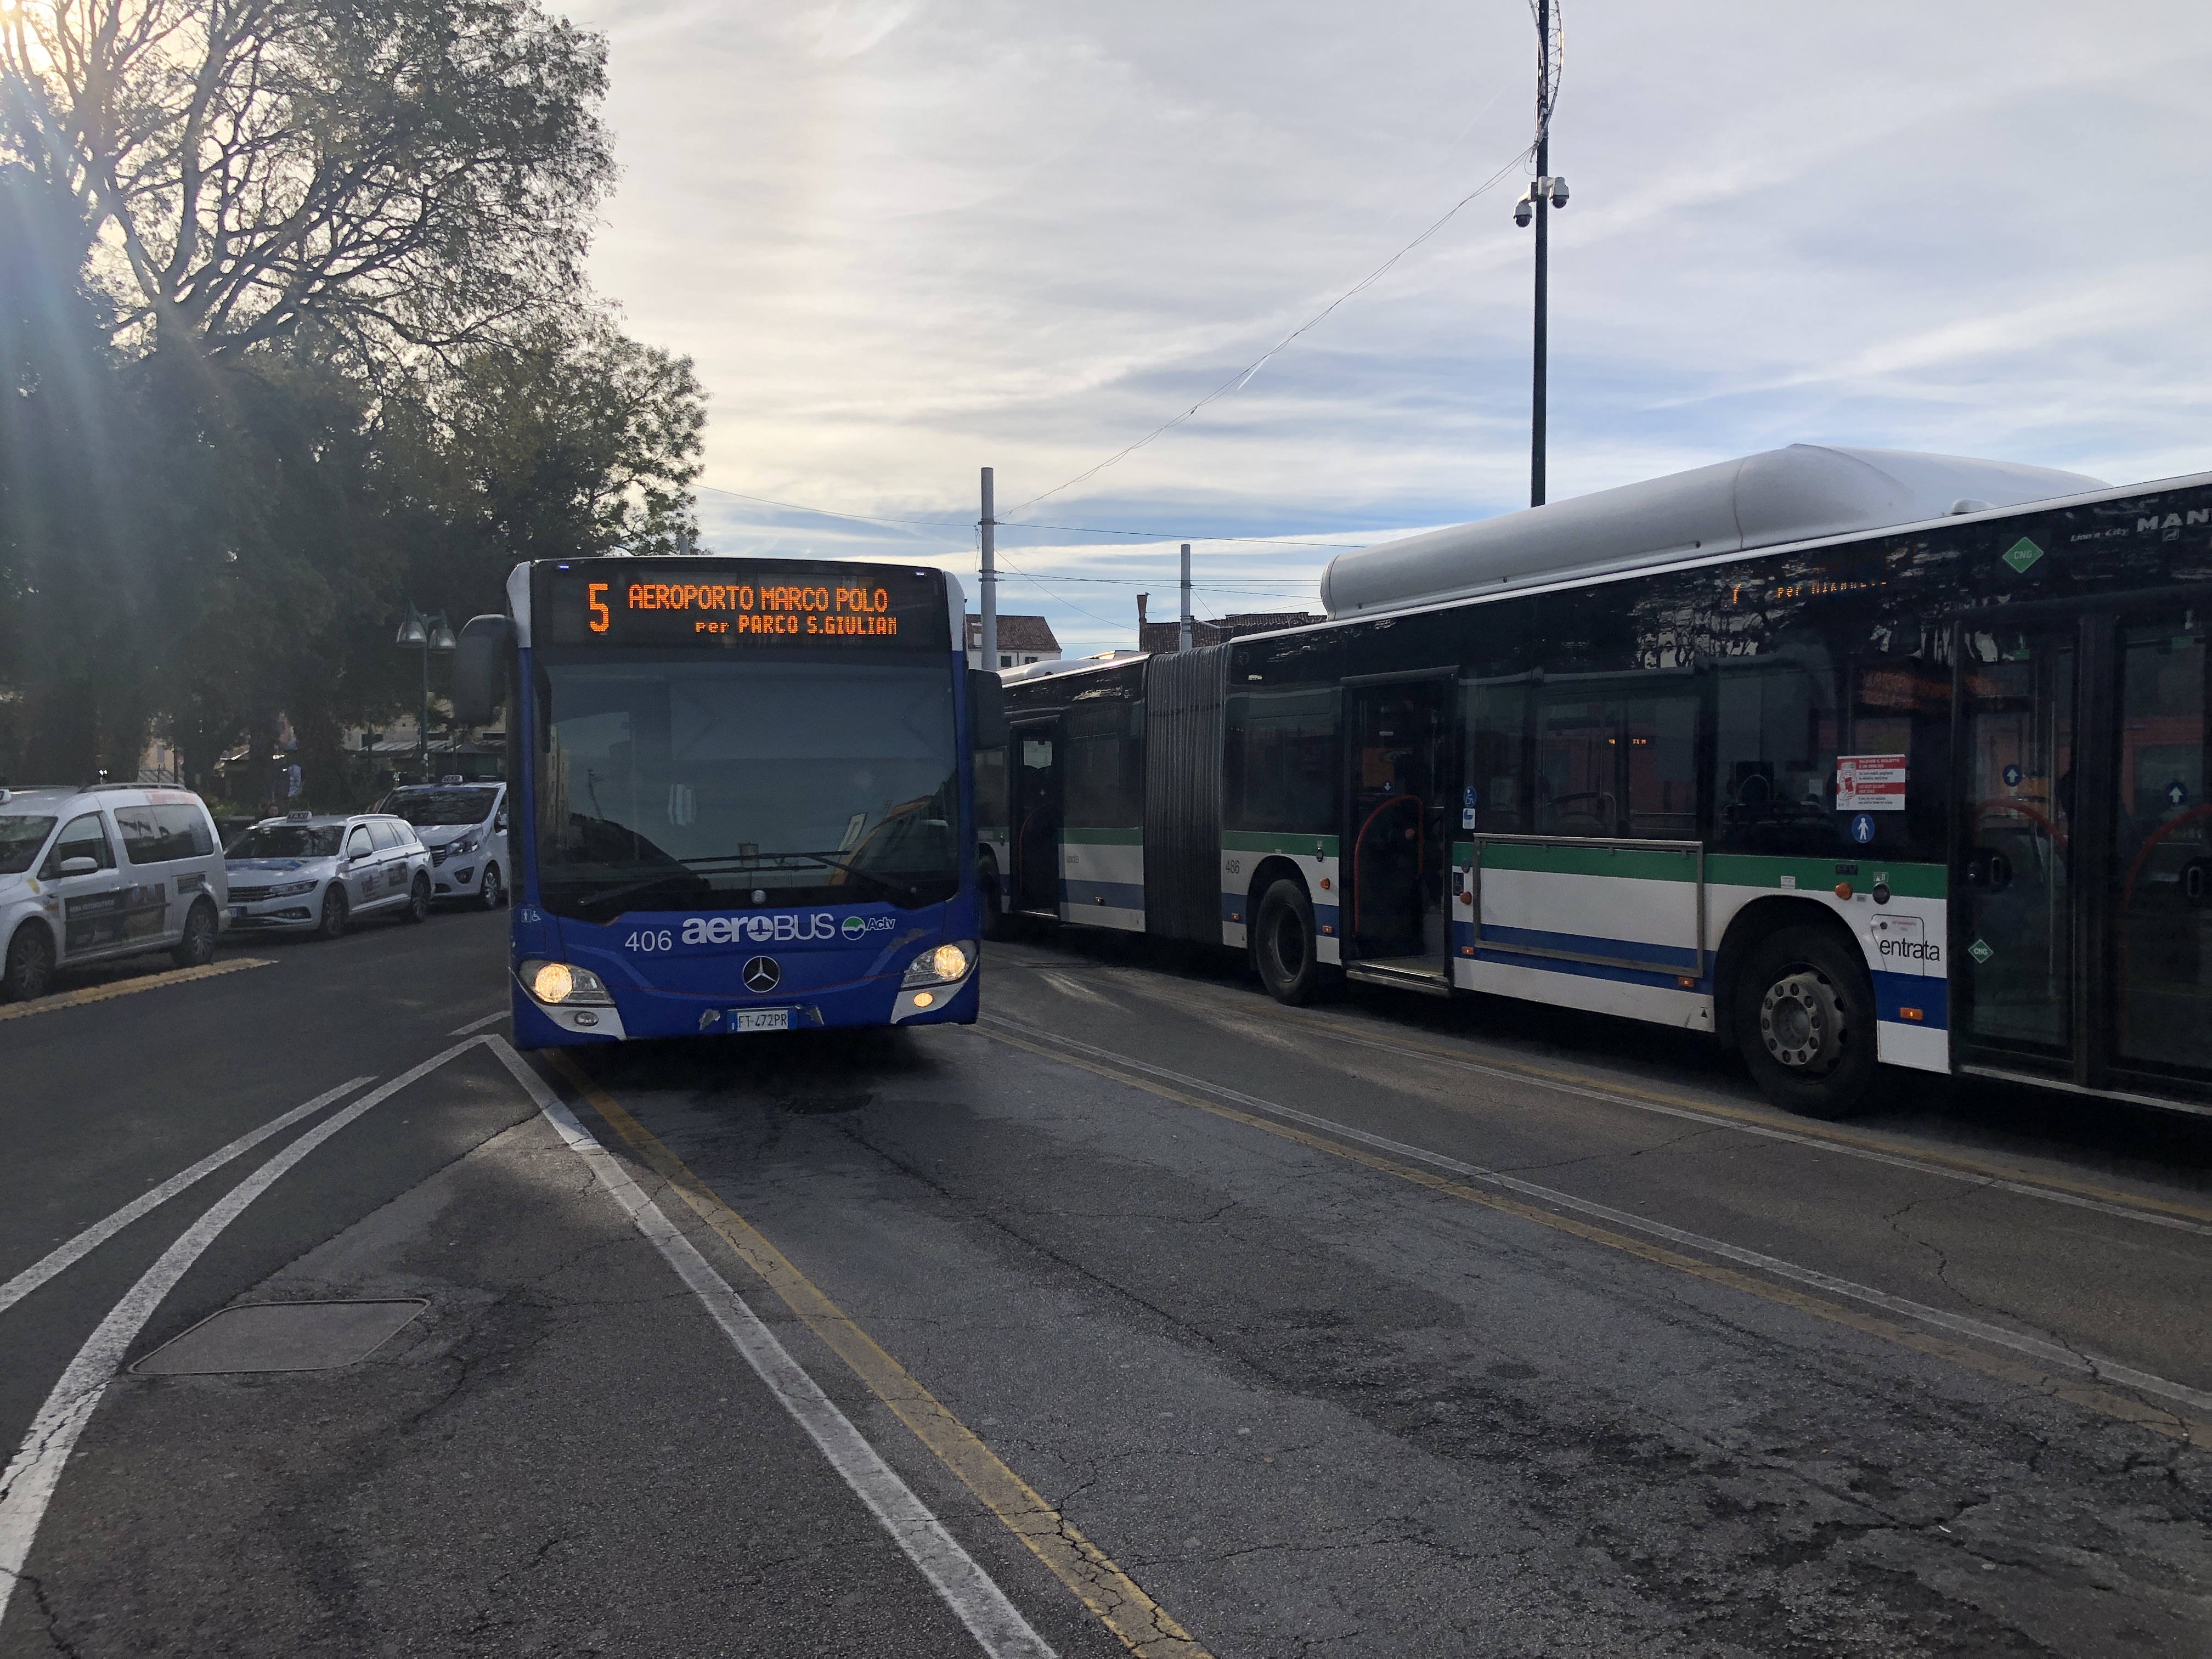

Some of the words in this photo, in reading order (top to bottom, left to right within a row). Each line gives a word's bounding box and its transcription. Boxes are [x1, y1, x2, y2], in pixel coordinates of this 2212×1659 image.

[2014, 550, 2033, 560] CNG
[589, 583, 610, 633] 5
[628, 584, 754, 611] AEROPORTO
[761, 586, 830, 612] MARCO
[836, 588, 888, 613] POLO
[695, 622, 730, 633] per
[738, 614, 798, 634] PARCO
[1225, 860, 1240, 874] 486
[867, 917, 896, 931] Actv
[624, 930, 673, 952] 406
[1880, 937, 1940, 962] entrata
[1973, 947, 1989, 956] CNG
